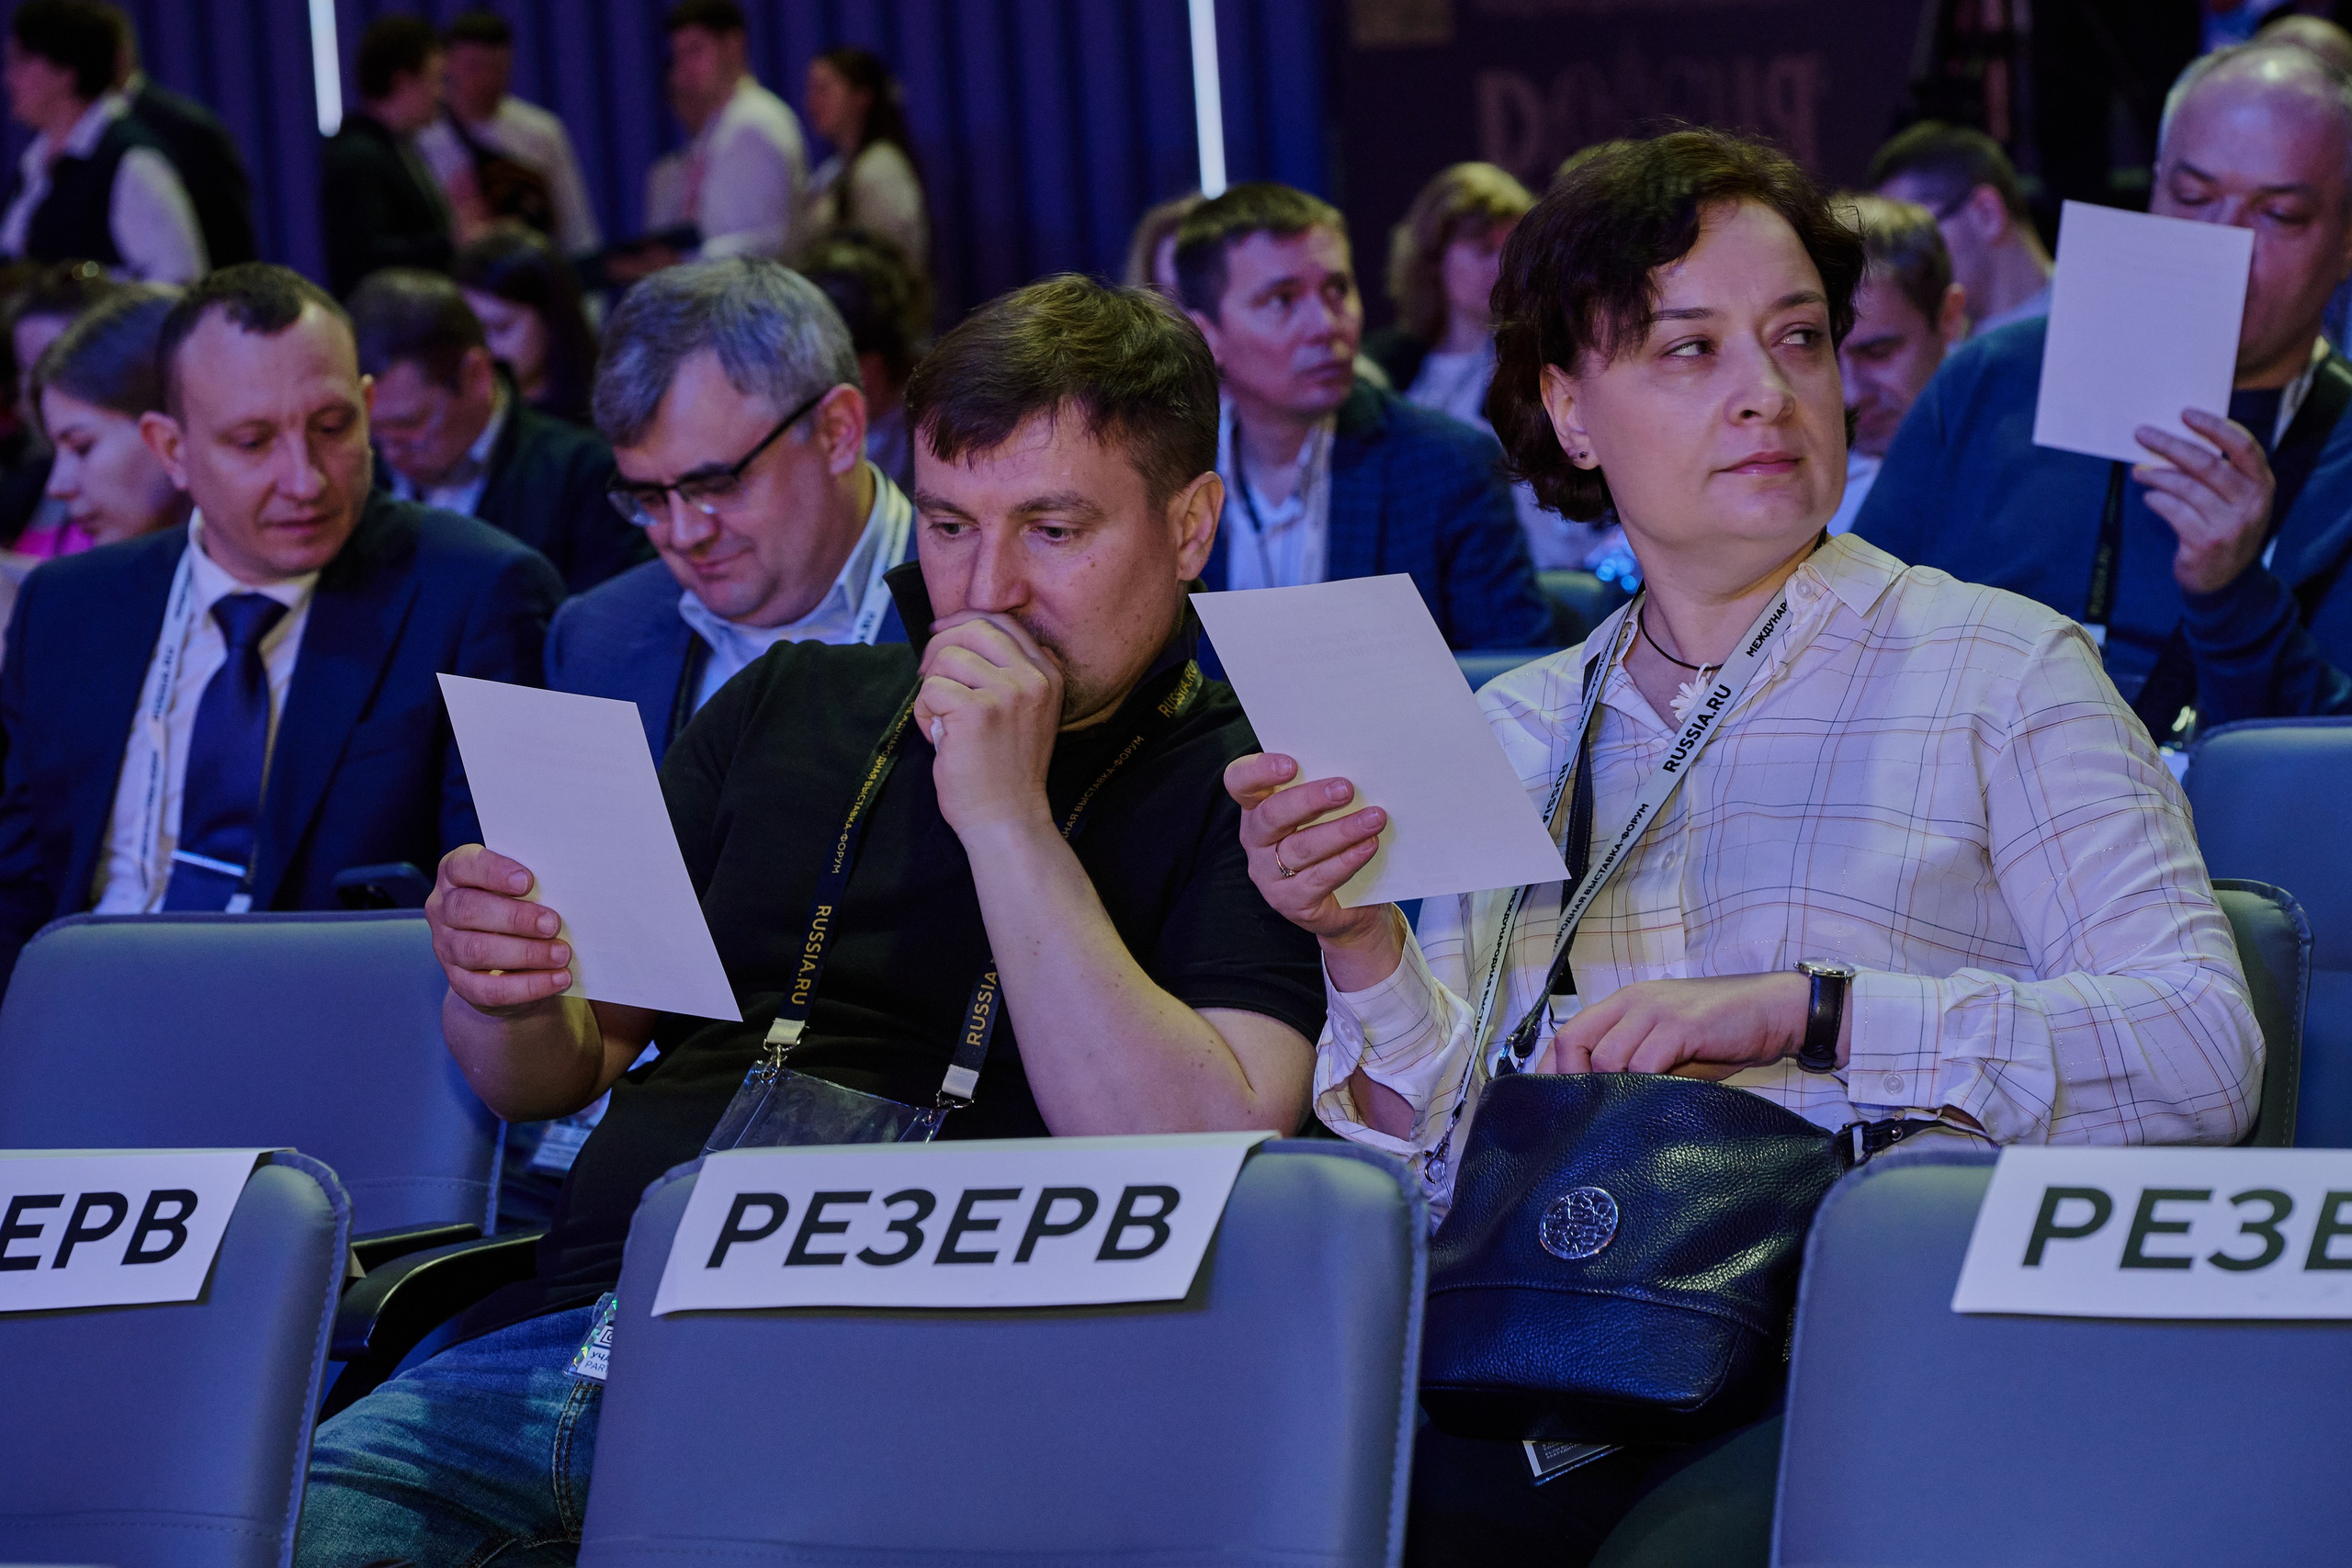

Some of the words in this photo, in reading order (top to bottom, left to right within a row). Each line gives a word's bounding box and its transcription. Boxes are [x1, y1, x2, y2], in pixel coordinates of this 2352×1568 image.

[1746, 600, 1788, 657] МЕЖДУНАР
[1662, 683, 1732, 773] RUSSIA.RU
[1074, 735, 1145, 812] ВЫСТАВКА-ФОРУМ
[831, 780, 873, 874] ВЫСТАВКА-ФОРУМ
[1584, 803, 1649, 896] ВЫСТАВКА-ФОРУМ
[791, 905, 832, 1006] RUSSIA.RU
[967, 957, 999, 1046] RUSSIA
[0, 1189, 198, 1271] ЕРВ
[705, 1185, 1182, 1269] РЕЗЕРВ
[585, 1361, 608, 1372] PAR
